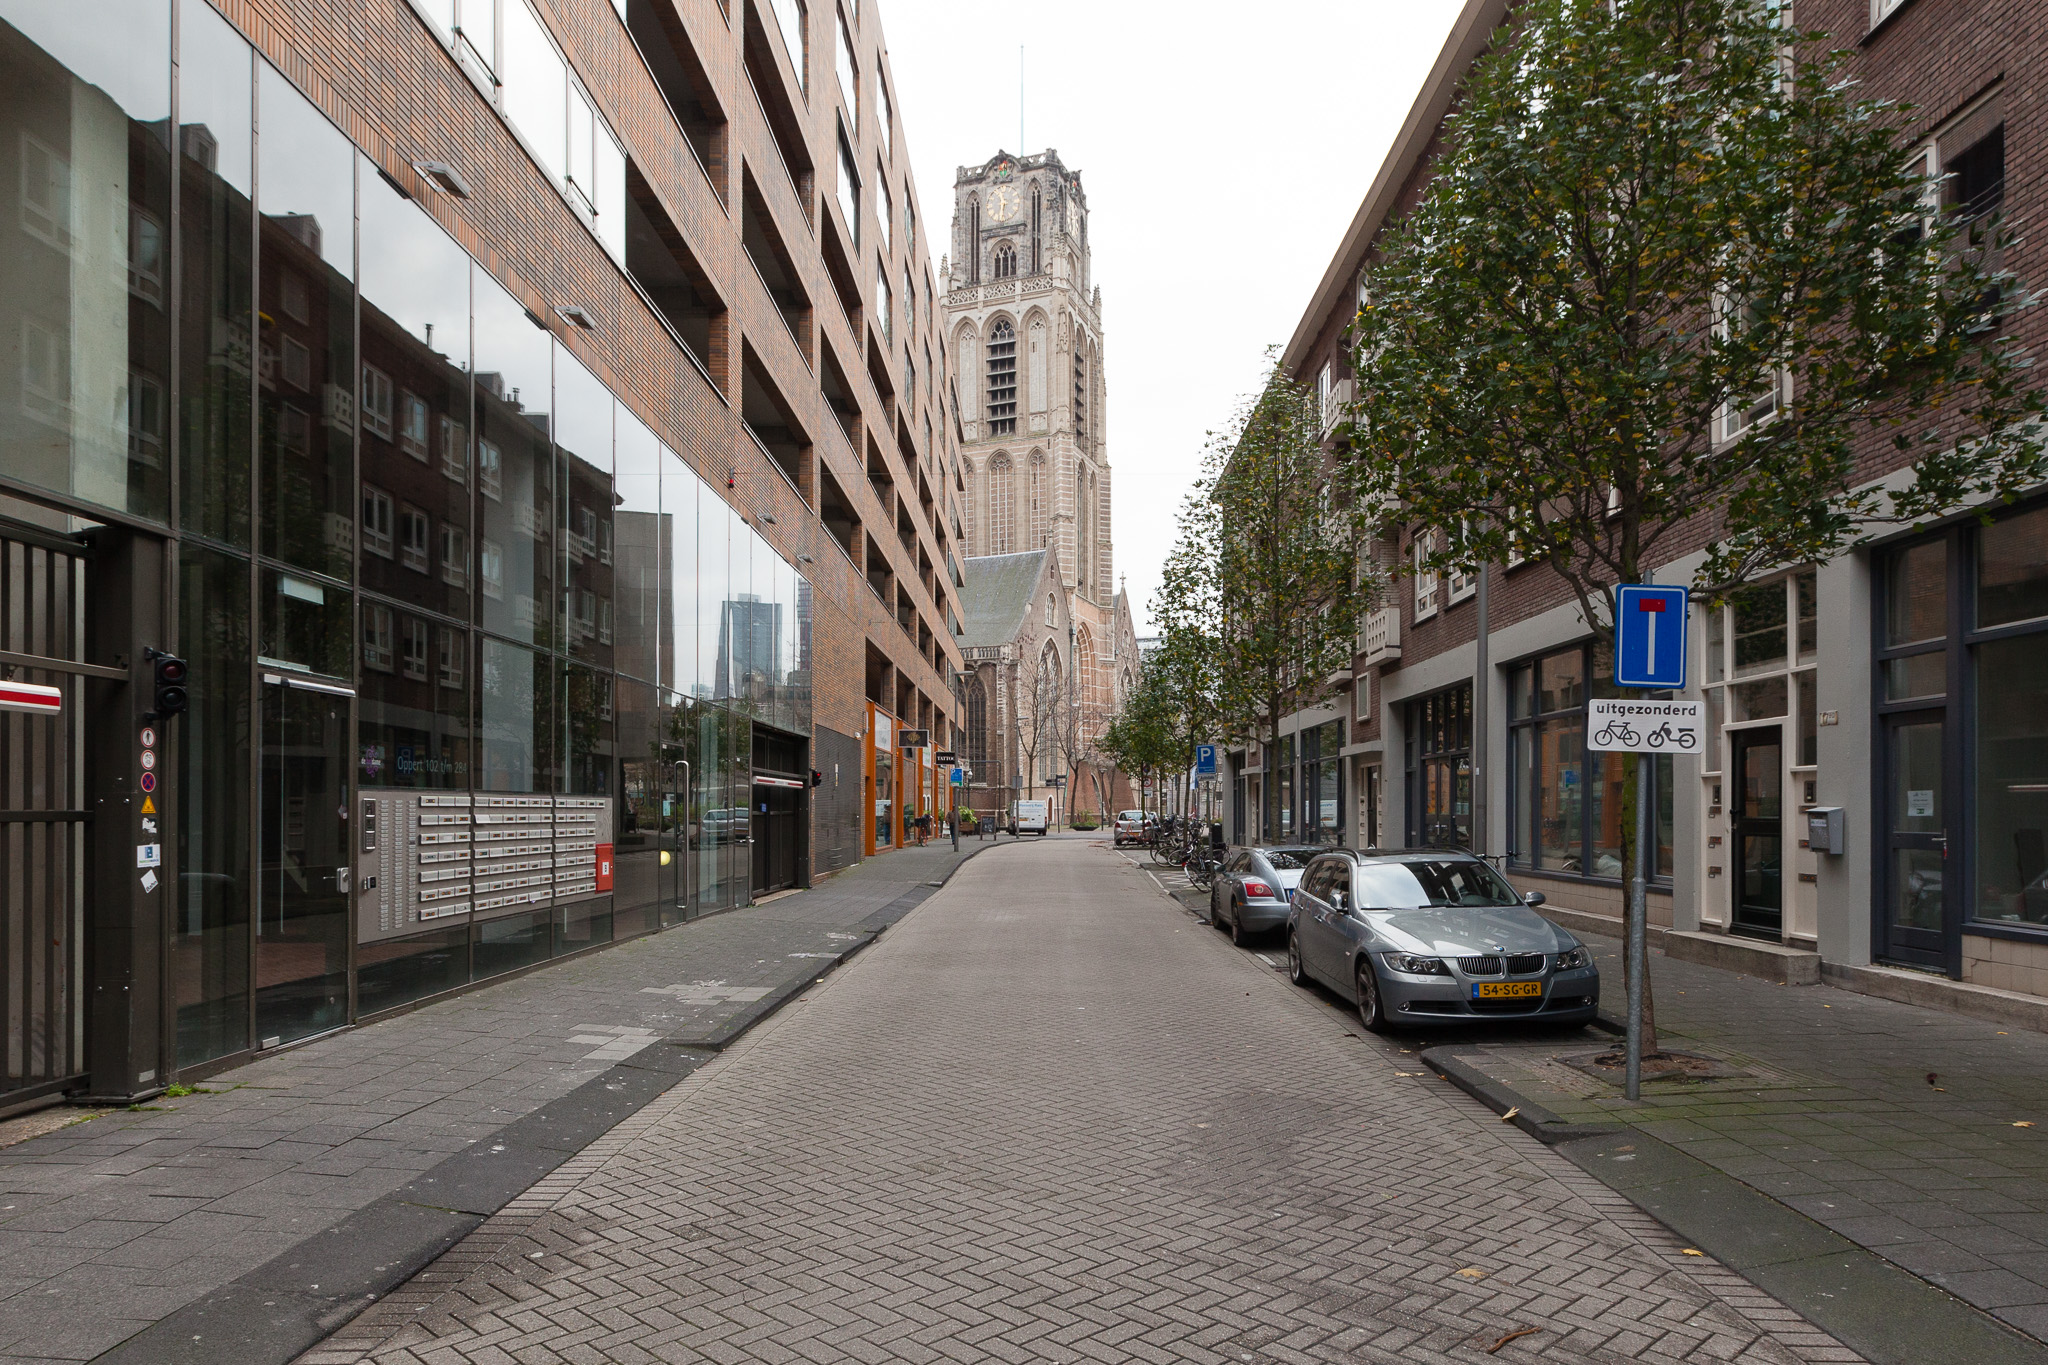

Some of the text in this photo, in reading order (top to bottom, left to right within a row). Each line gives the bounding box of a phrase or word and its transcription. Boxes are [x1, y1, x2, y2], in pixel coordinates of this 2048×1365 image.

[1596, 703, 1696, 717] uitgezonderd
[1200, 748, 1211, 762] P
[397, 756, 467, 774] Oppert 102 t/m 284
[1484, 984, 1538, 996] 54-SG-GR
